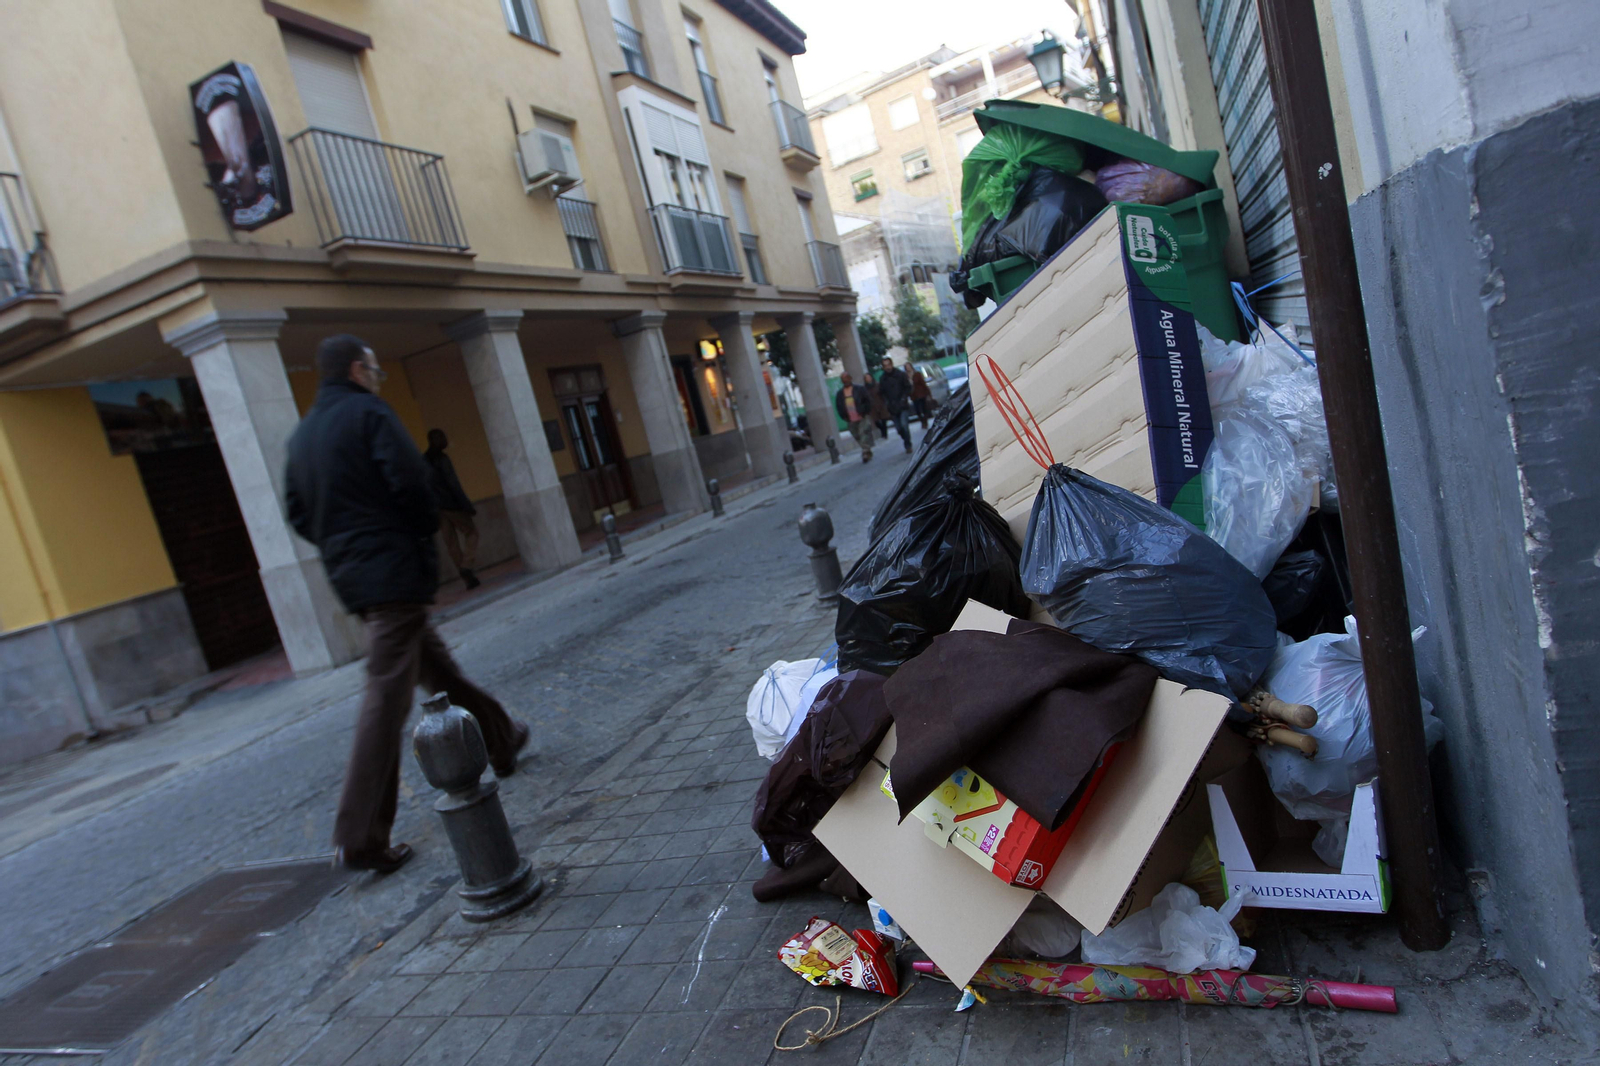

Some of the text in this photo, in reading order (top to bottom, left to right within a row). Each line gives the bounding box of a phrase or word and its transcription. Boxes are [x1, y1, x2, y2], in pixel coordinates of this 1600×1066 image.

[1141, 227, 1149, 247] Cuida
[1158, 225, 1178, 251] botella
[1145, 263, 1172, 275] friendly
[1159, 309, 1199, 469] Agua Mineral Natural
[1234, 884, 1373, 901] SMIDESNATADA
